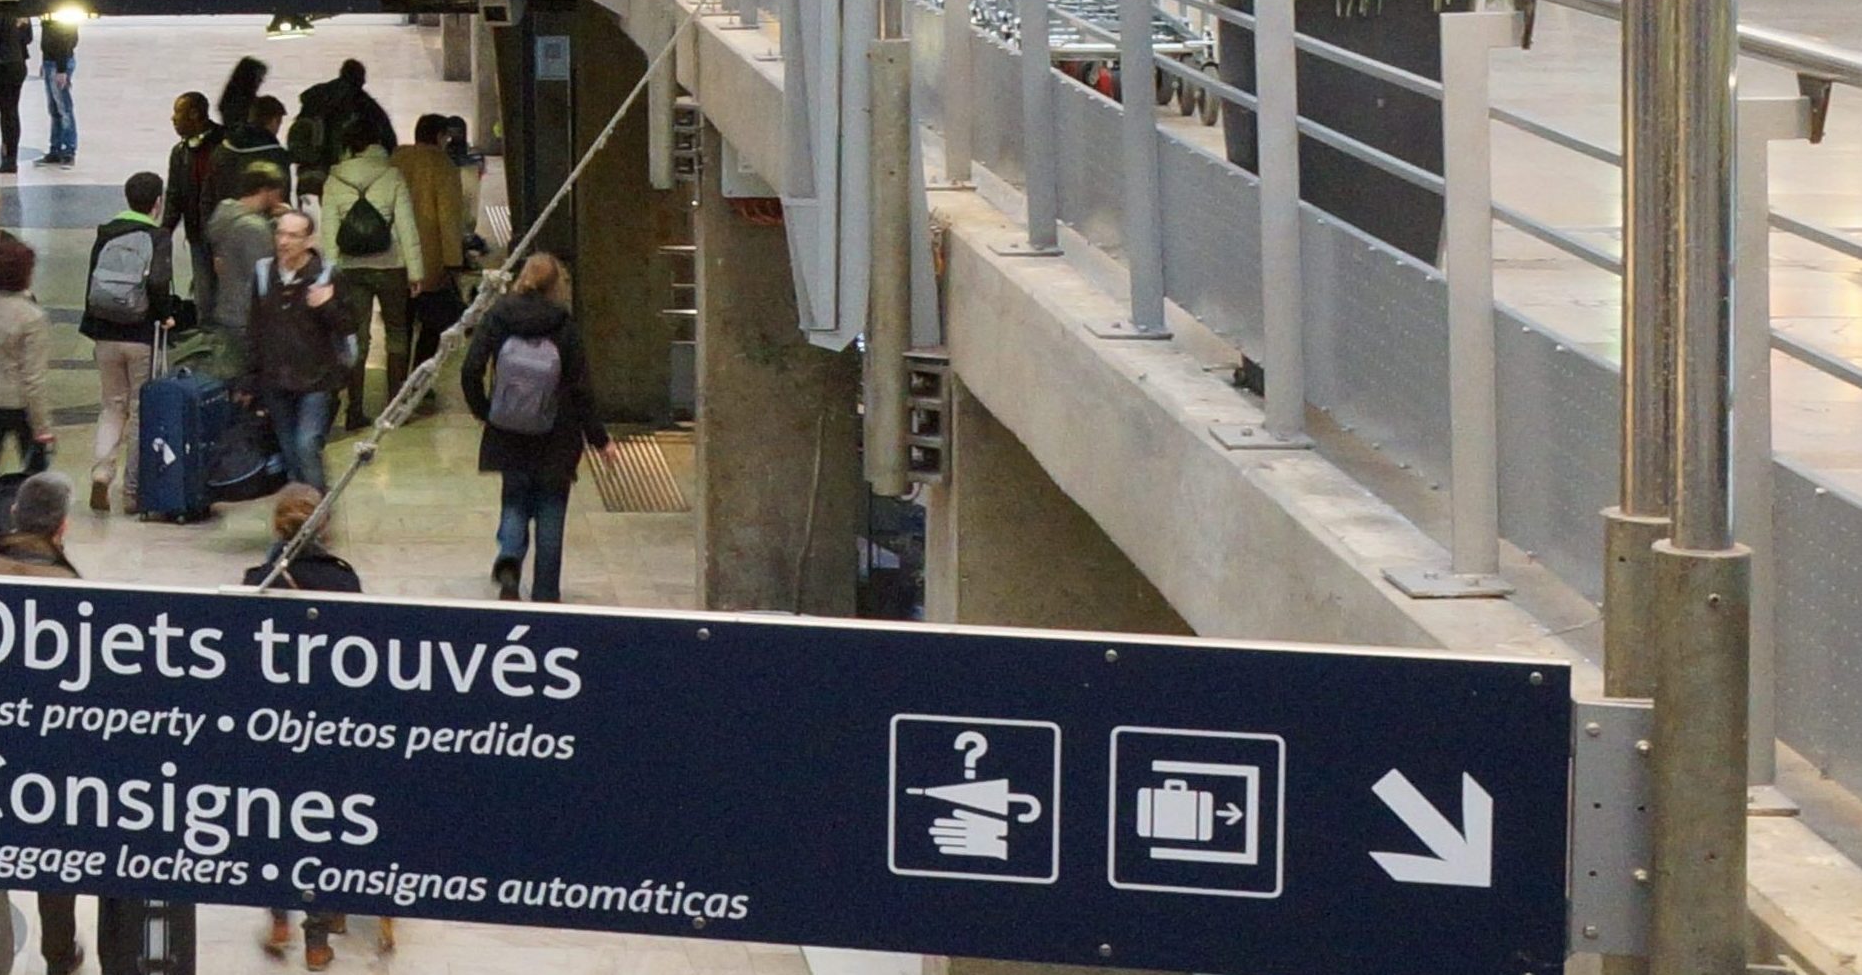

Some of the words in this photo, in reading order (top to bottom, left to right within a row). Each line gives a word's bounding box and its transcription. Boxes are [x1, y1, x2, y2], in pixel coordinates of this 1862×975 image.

[254, 619, 583, 700] trouvés
[40, 700, 206, 746] property
[246, 708, 396, 756] Objetos
[404, 722, 575, 761] perdidos
[114, 847, 249, 886] lockers
[291, 854, 488, 908] Consignas
[496, 875, 749, 921] automáticas
